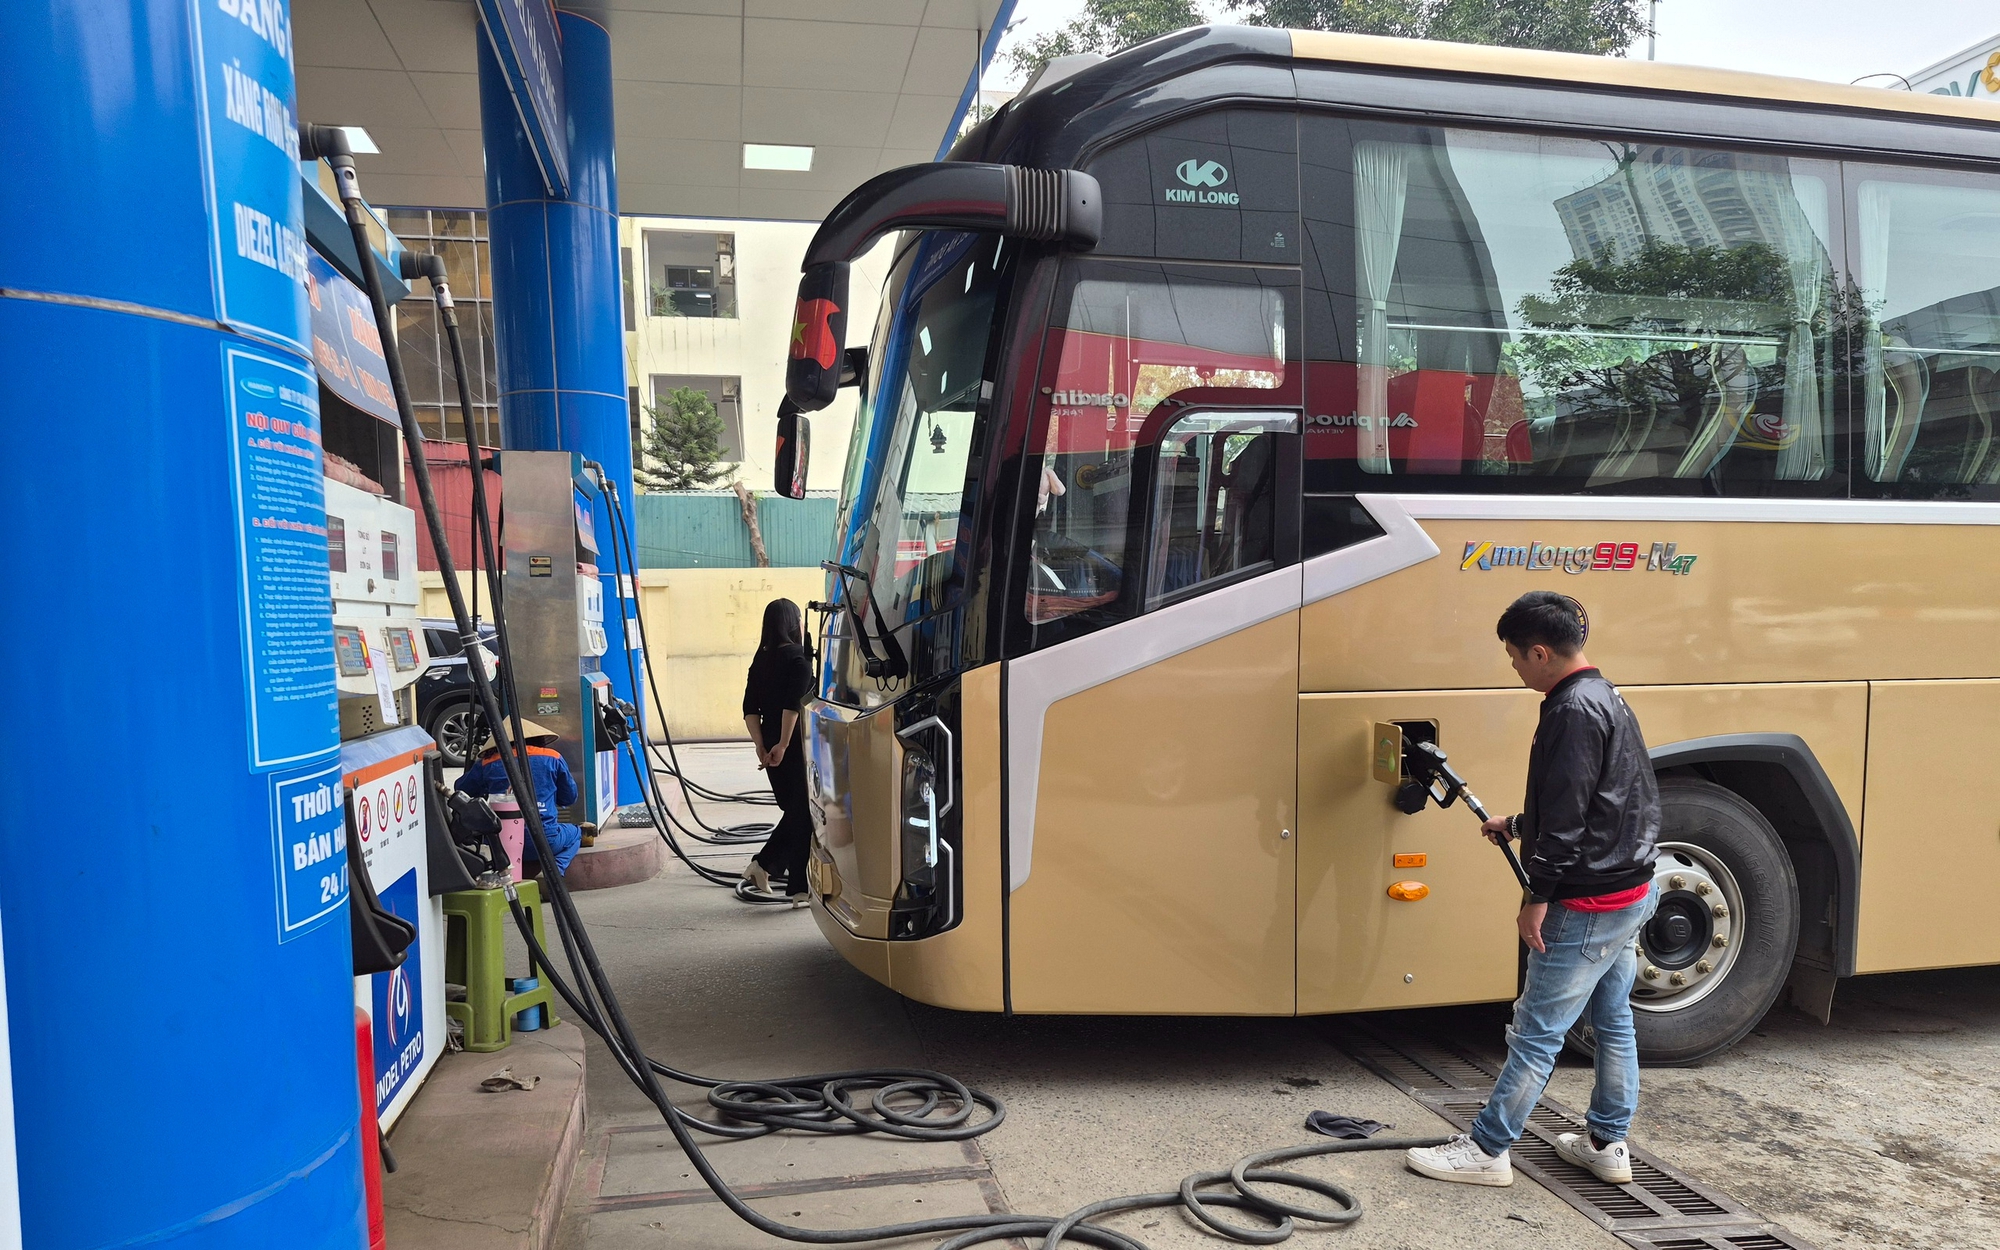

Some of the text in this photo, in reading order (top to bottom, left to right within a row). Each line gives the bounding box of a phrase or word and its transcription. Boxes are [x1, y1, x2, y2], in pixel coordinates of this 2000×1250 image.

[221, 56, 264, 138] XĂNG
[1165, 188, 1240, 205] KIM LONG
[233, 201, 278, 270] DIEZEL
[246, 411, 269, 433] NỘI
[270, 417, 291, 434] QUY
[292, 782, 332, 823] THỜI
[292, 831, 332, 871] BÁN
[376, 1029, 422, 1108] INDEL PETRO
